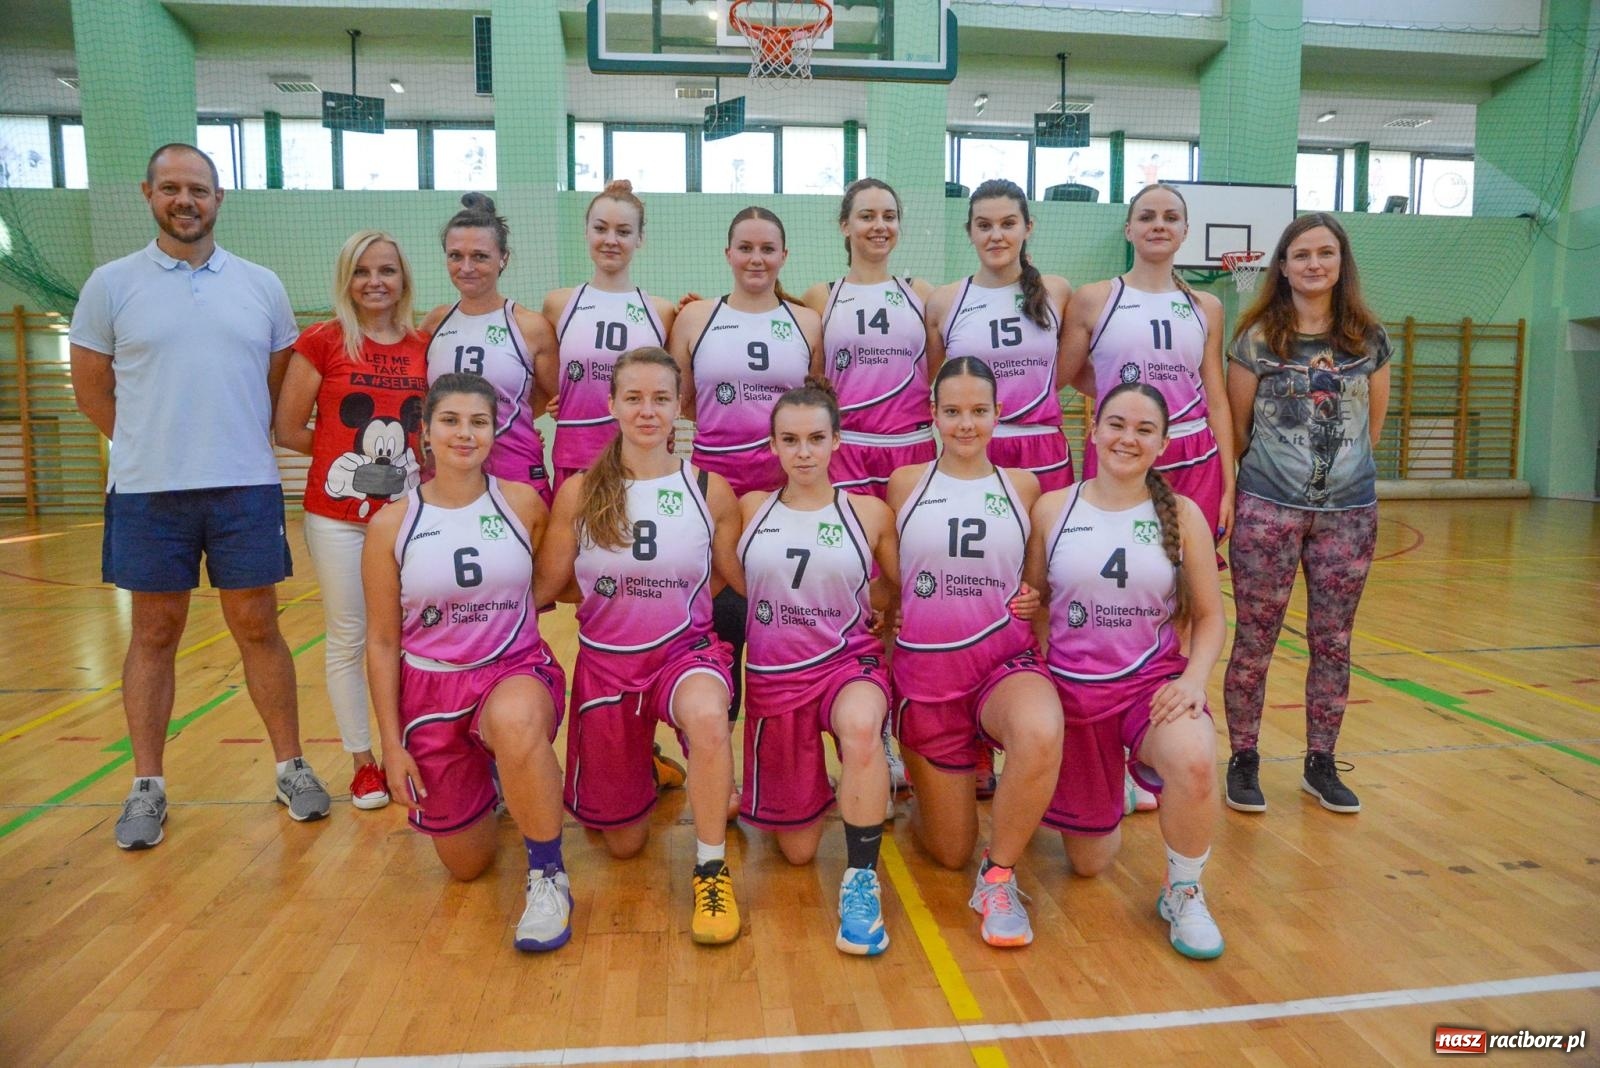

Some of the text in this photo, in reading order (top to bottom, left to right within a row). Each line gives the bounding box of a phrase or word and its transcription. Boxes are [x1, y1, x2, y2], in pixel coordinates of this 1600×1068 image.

[595, 321, 627, 351] 10
[856, 308, 890, 335] 14
[989, 317, 1022, 349] 15
[1150, 319, 1172, 350] 11
[365, 353, 411, 366] LET ME
[454, 345, 485, 376] 13
[747, 341, 769, 371] 9
[858, 347, 912, 357] Politechnika
[353, 375, 367, 385] A
[372, 364, 408, 376] TAKE
[632, 520, 657, 561] 8
[948, 517, 987, 558] 12
[453, 547, 483, 588] 6
[786, 548, 811, 589] 7
[1100, 547, 1128, 588] 4
